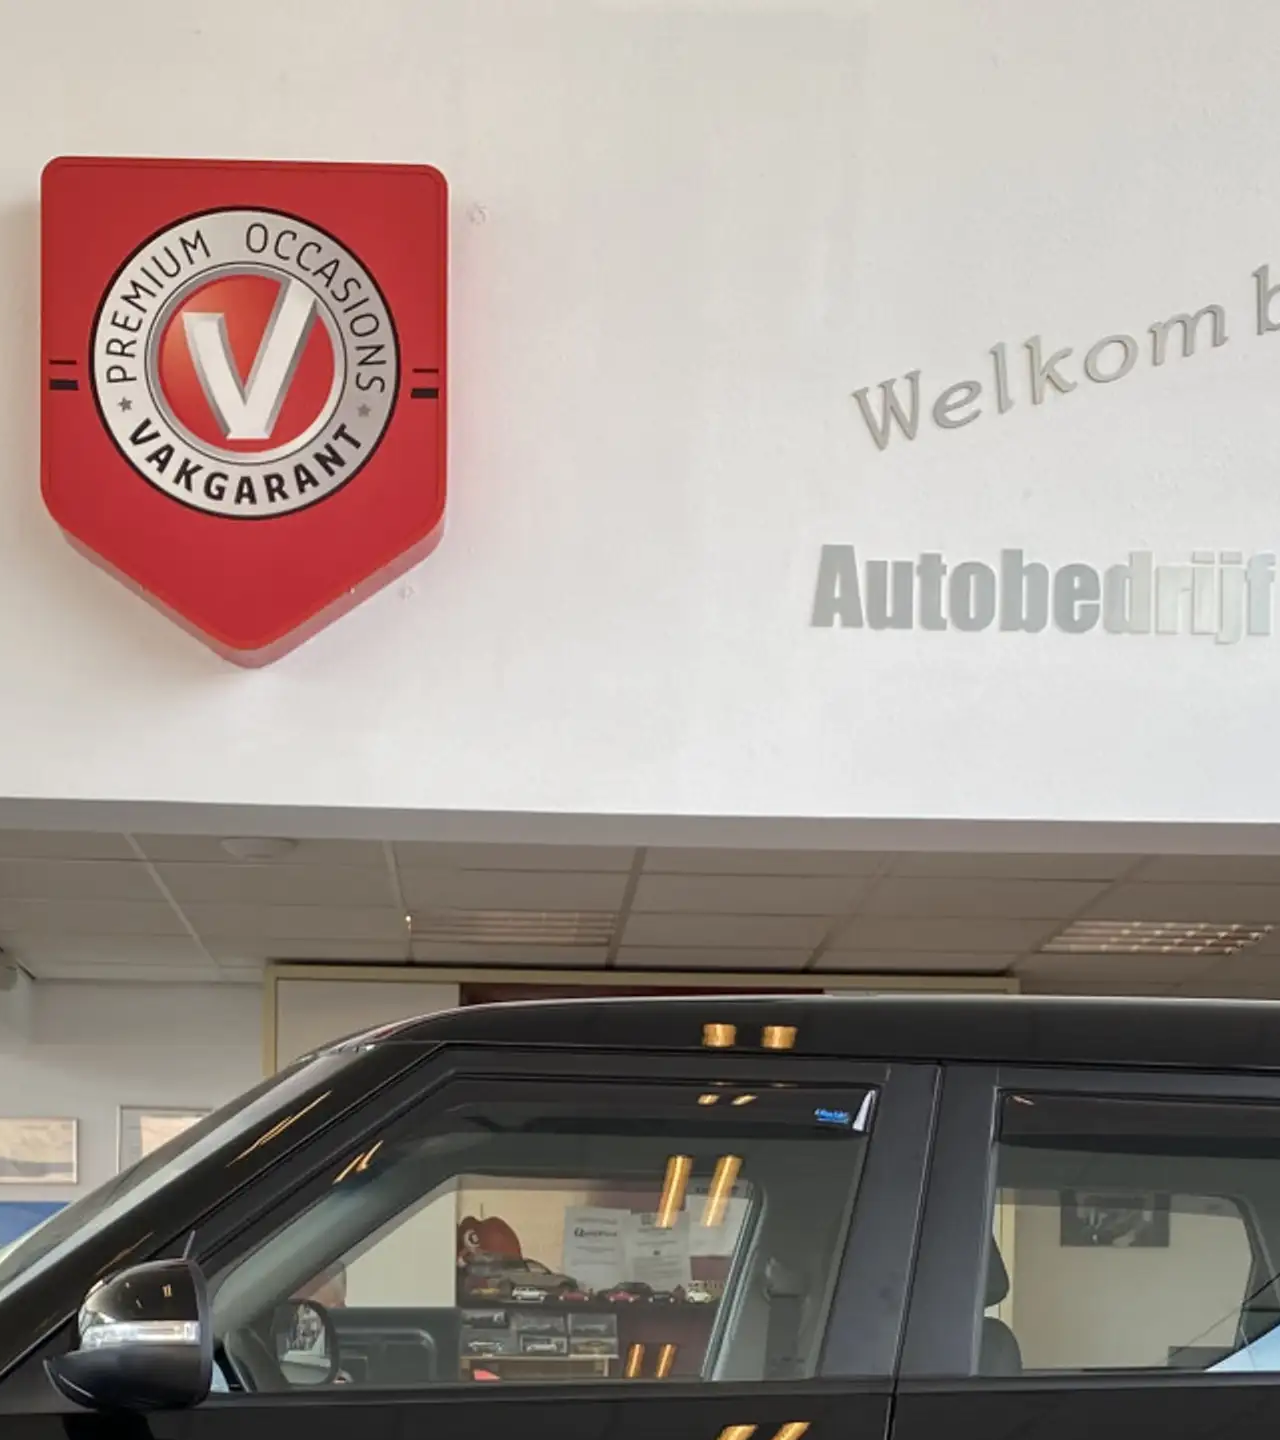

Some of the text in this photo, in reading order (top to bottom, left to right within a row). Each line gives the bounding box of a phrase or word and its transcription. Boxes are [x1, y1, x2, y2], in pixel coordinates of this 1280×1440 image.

[106, 222, 385, 393] PREMIUM OCCASIONS
[851, 300, 1229, 452] Welkom
[128, 418, 363, 506] VAKGARANT
[810, 543, 1276, 646] Autobedrijf
